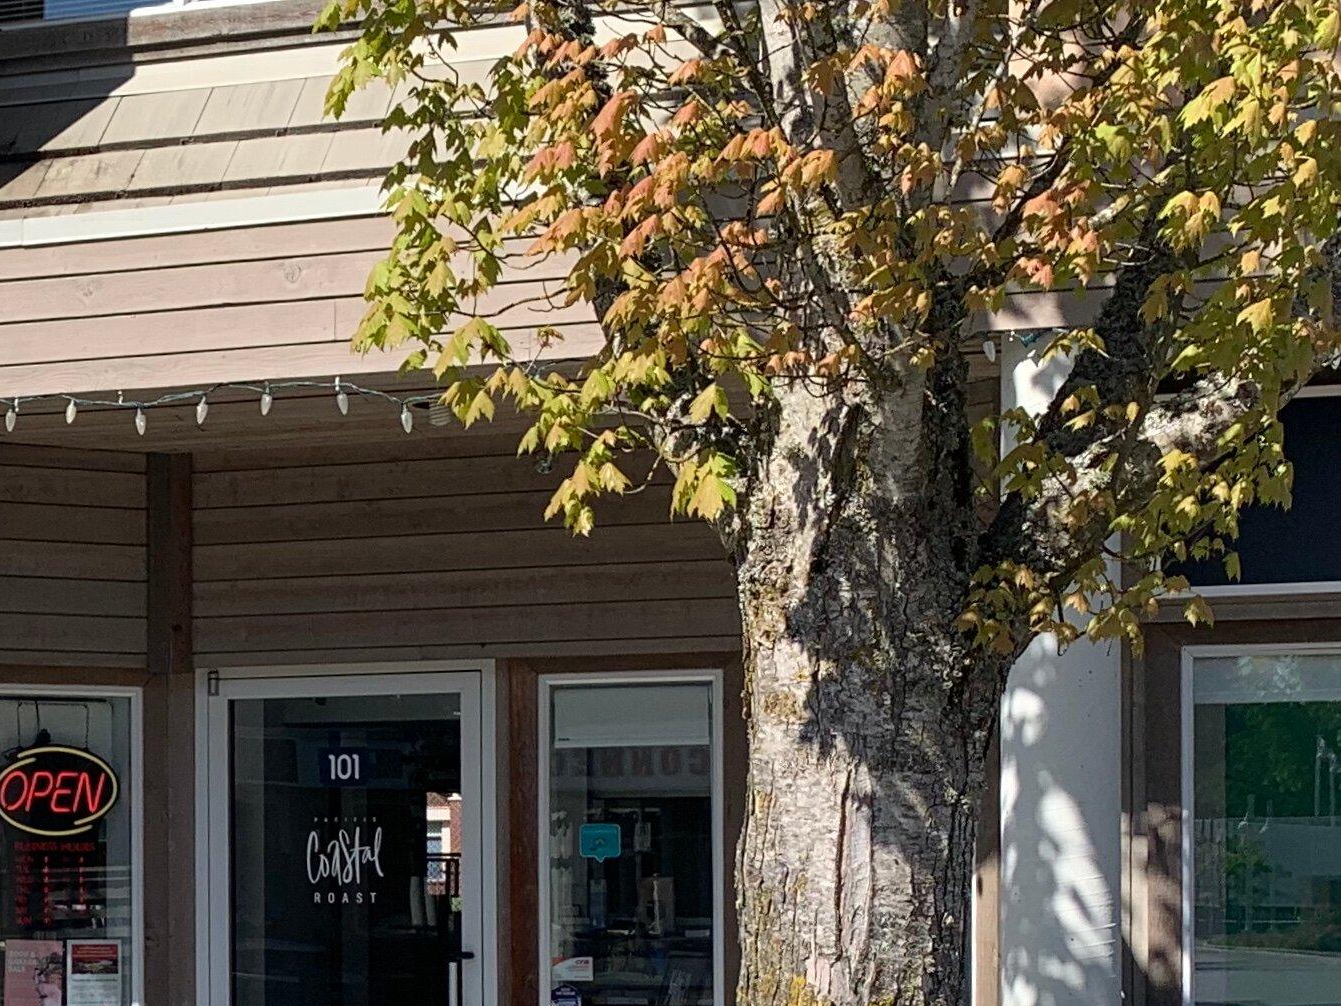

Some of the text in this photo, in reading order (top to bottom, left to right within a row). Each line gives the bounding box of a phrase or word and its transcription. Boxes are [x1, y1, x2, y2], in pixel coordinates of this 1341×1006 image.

[328, 753, 360, 780] 101
[0, 771, 105, 813] OPEN
[306, 826, 384, 887] Coastal
[314, 892, 377, 904] ROAST
